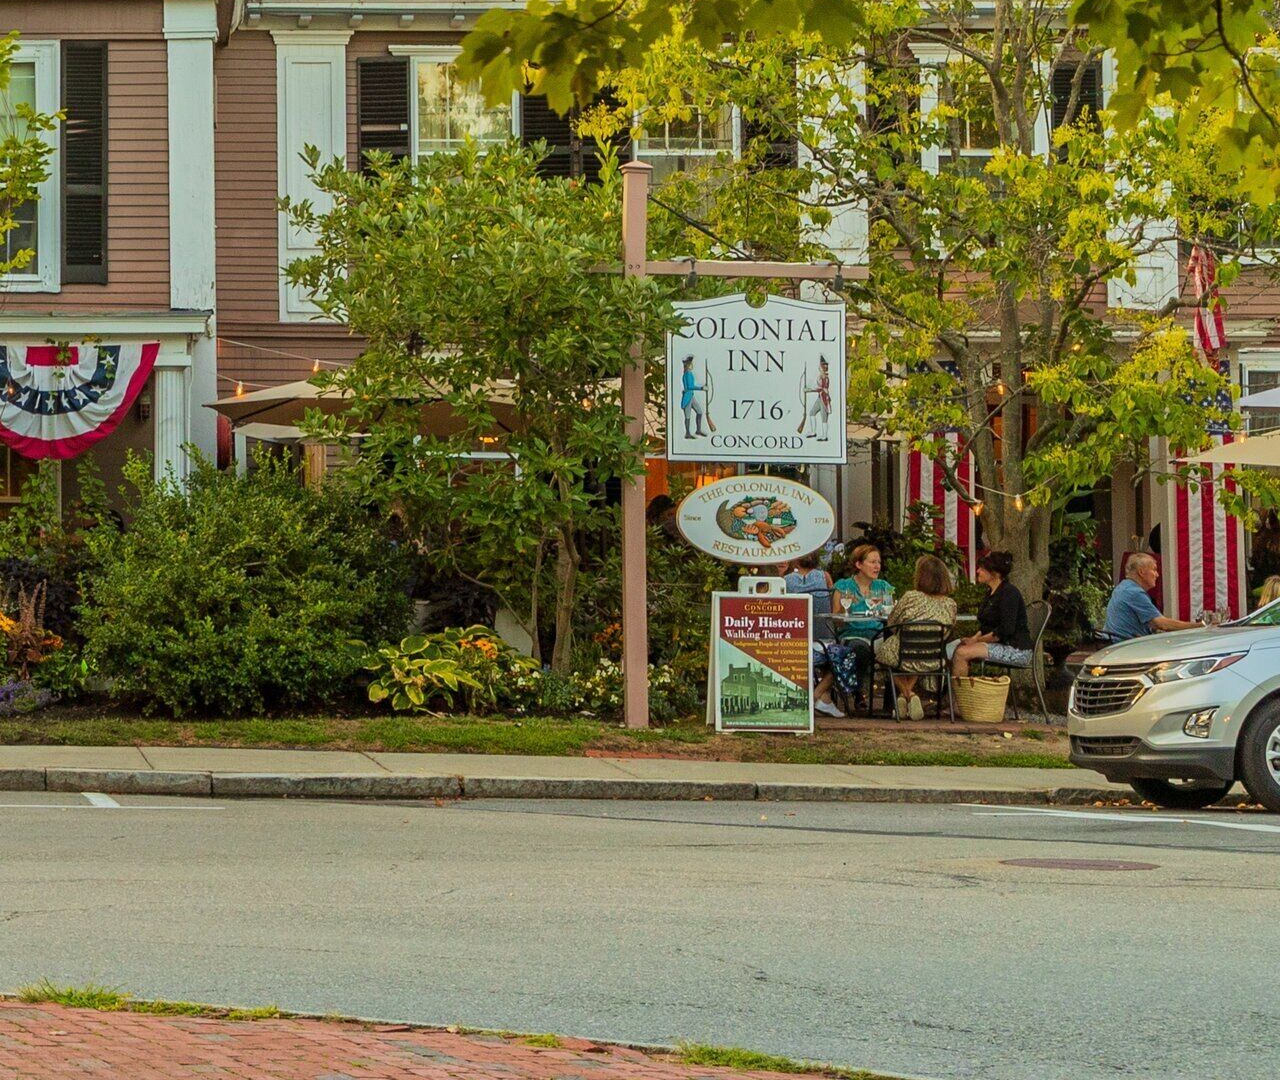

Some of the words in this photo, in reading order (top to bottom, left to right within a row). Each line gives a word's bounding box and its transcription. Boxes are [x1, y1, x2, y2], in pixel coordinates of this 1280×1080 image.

[727, 349, 786, 372] INN
[730, 399, 784, 420] 1716
[710, 434, 804, 450] CONCORD
[698, 487, 725, 504] THE
[725, 481, 789, 497] COLONIAL
[791, 488, 815, 506] INN
[712, 539, 801, 558] RESTAURANTS
[744, 603, 785, 612] CONCORD
[724, 616, 755, 631] Daily
[758, 616, 805, 628] Historic
[725, 629, 760, 641] Walking
[762, 629, 783, 639] Tour
[784, 631, 792, 639] &
